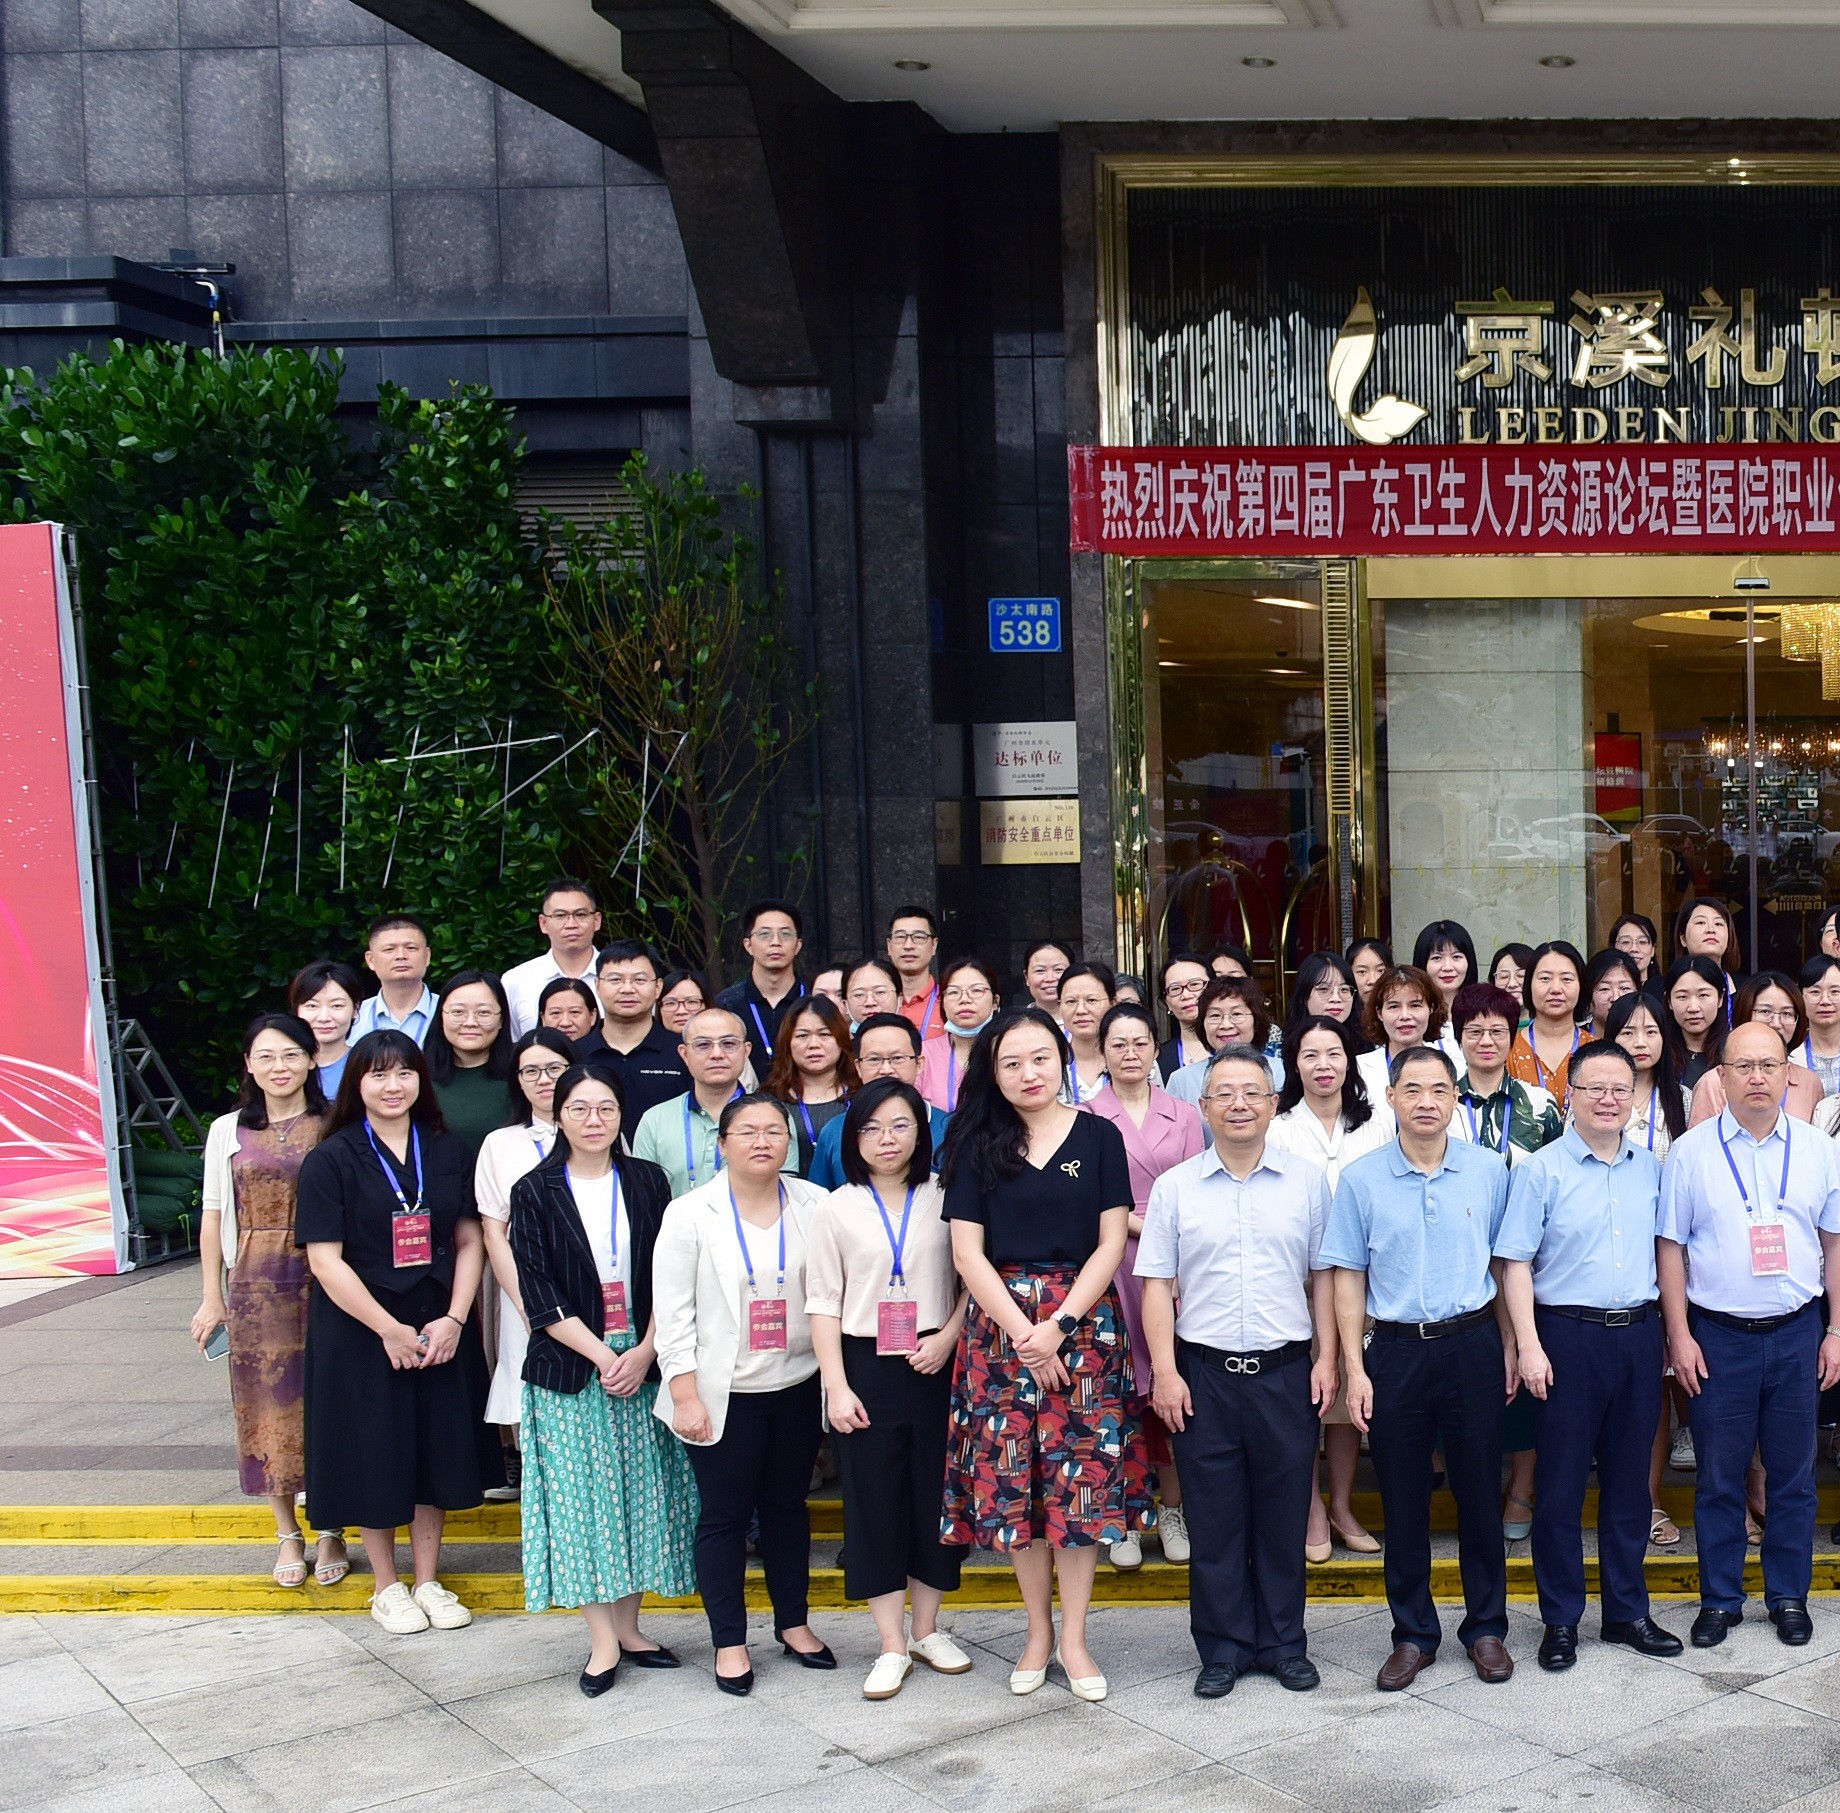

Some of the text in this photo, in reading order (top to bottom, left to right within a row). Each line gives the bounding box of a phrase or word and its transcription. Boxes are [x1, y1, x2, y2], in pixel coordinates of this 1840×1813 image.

[1458, 406, 1691, 444] LEEDEN
[996, 603, 1053, 616] 沙太南路
[1000, 620, 1051, 646] 538
[995, 750, 1062, 766] 达标单位
[986, 827, 1075, 843] 消防安全重点单位
